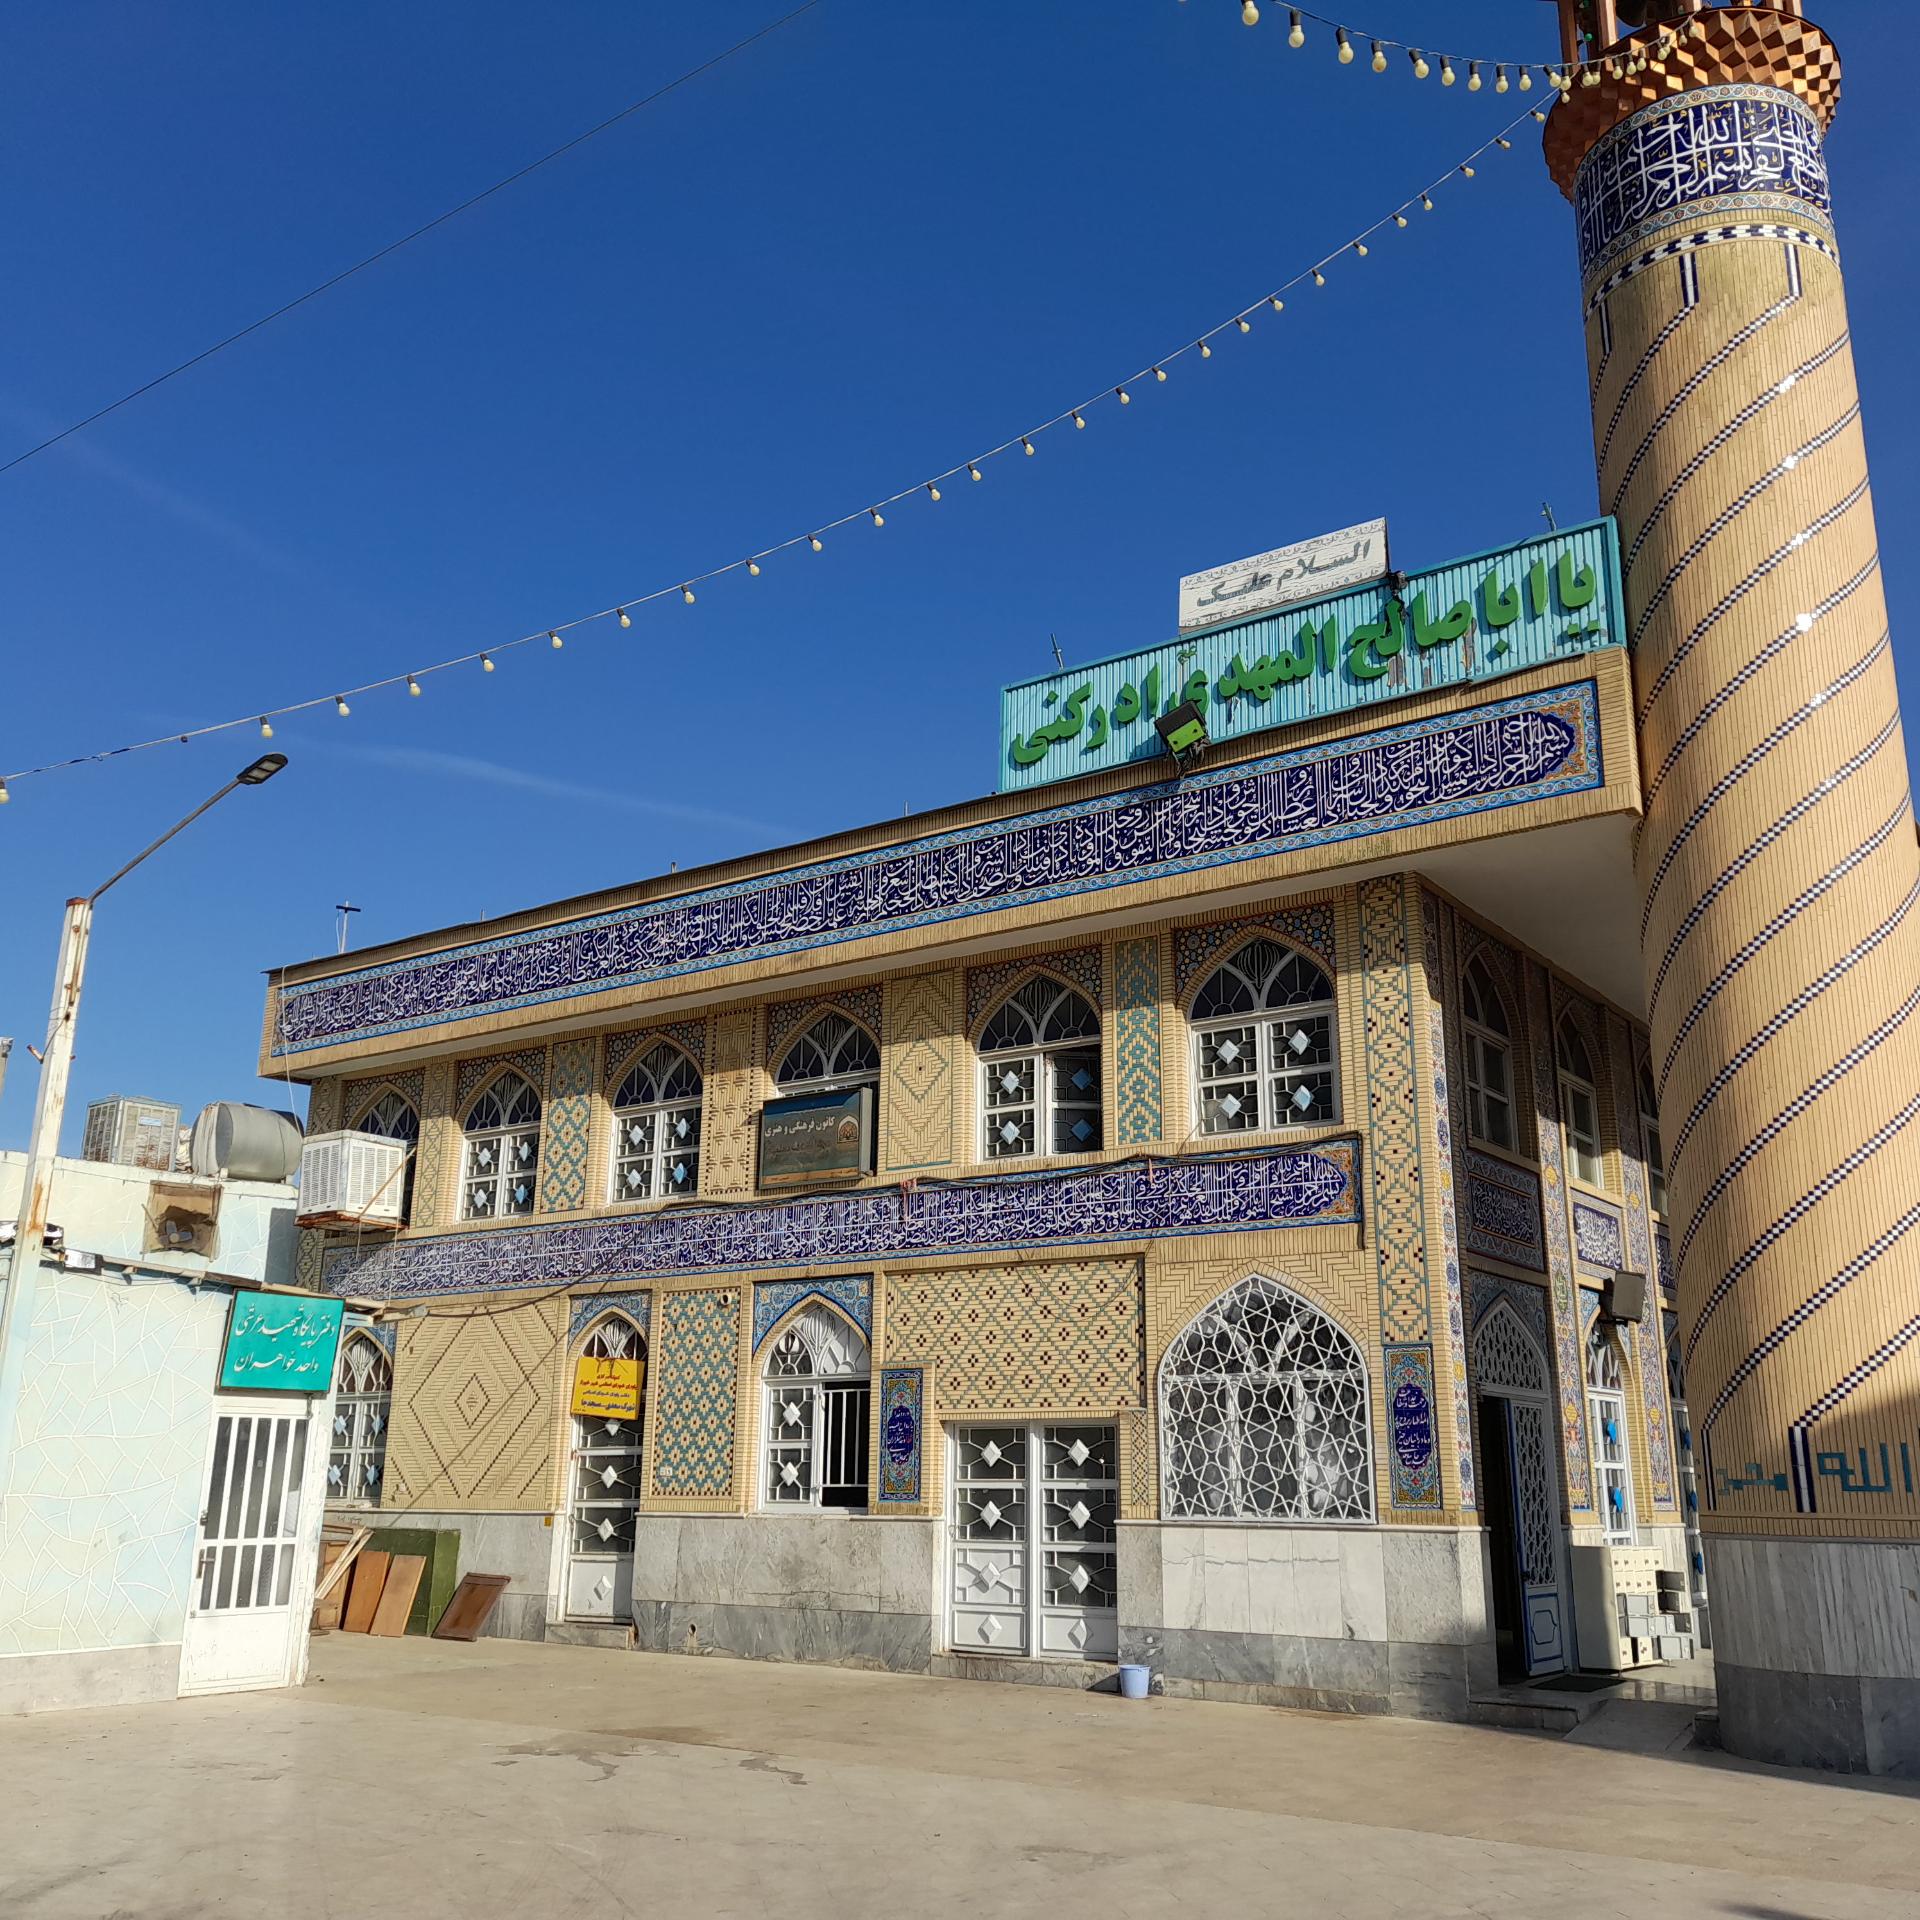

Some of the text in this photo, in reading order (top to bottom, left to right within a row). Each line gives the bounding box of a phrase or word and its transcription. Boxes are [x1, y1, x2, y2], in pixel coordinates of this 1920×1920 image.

[1277, 540, 1371, 591] السلام
[1556, 547, 1600, 637] یا
[1012, 662, 1160, 765] ادرکنی
[765, 1116, 836, 1137] کانون فرهنگی و هنری
[257, 1303, 304, 1342] شهید
[292, 1311, 316, 1348] پایگاه
[313, 1313, 336, 1345] دفتر
[234, 1350, 320, 1373] واحد خواهران
[1816, 1442, 1913, 1493] الله
